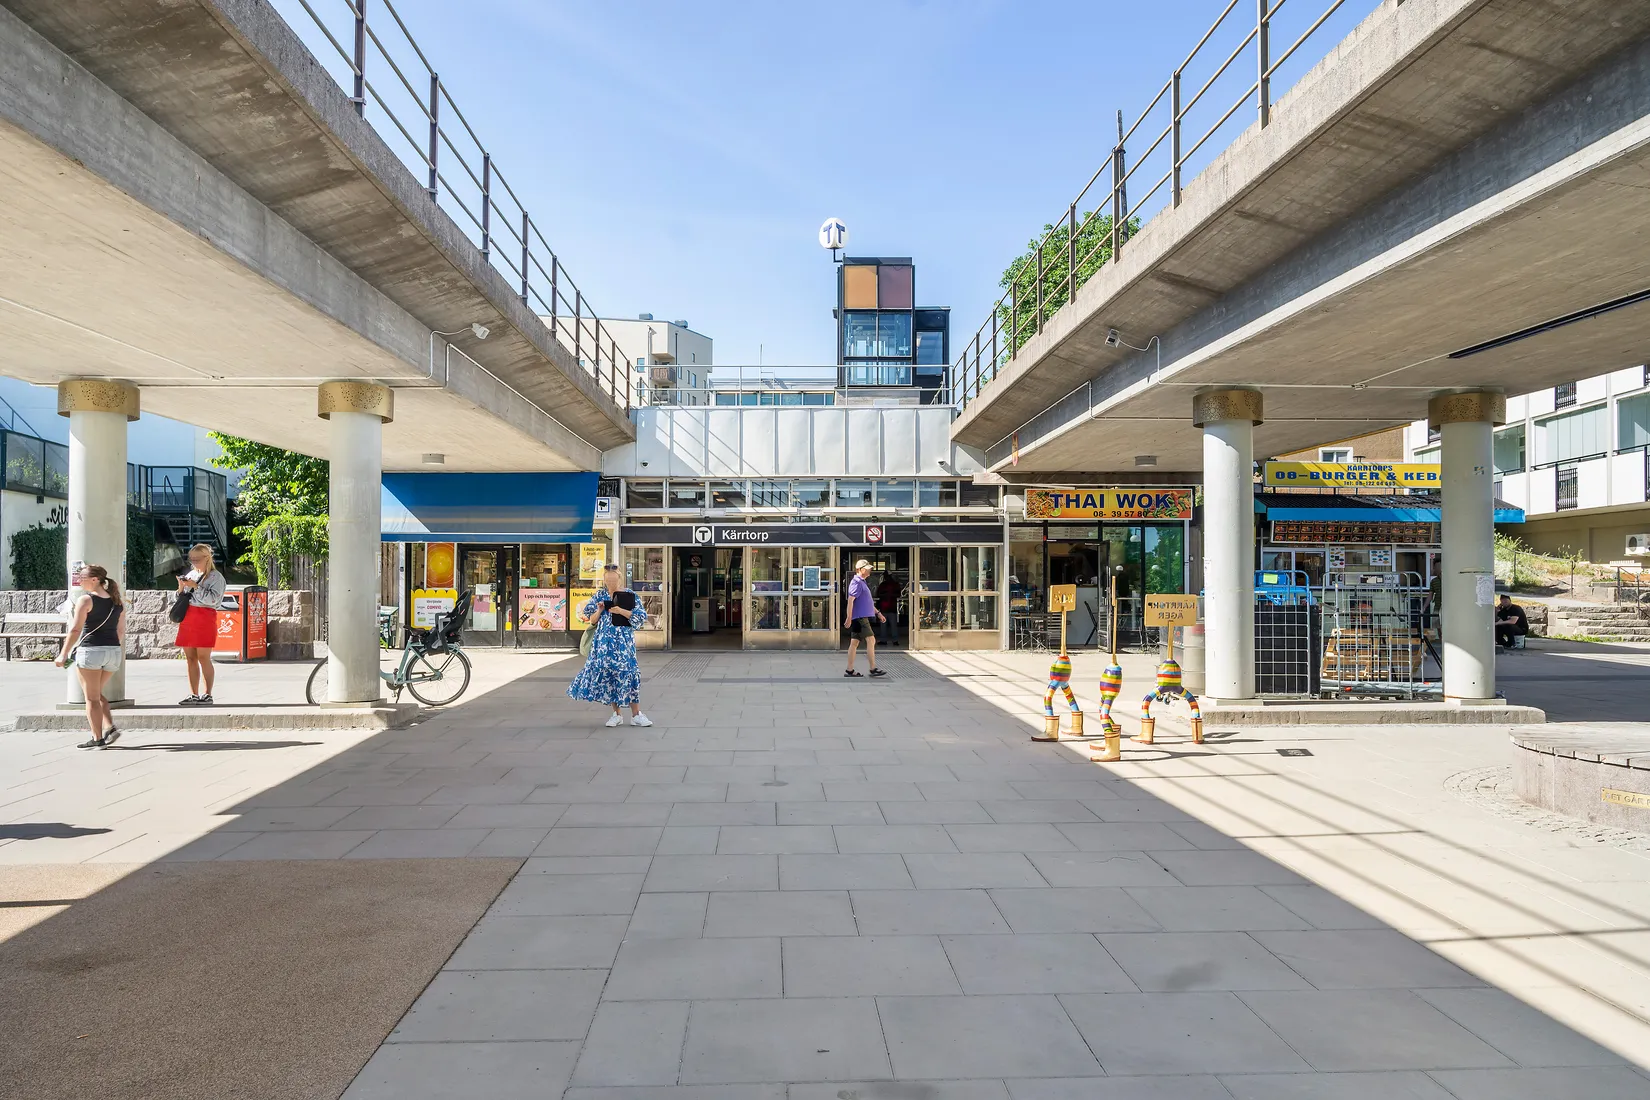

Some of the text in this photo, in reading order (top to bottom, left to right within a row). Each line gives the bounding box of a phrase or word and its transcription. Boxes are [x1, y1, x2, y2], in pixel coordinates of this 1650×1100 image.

[836, 222, 845, 244] T
[1386, 471, 1397, 481] &
[1404, 471, 1442, 481] KEB
[1049, 493, 1171, 509] THAI WOK
[1093, 510, 1148, 518] 08- 39 57 80
[698, 530, 709, 541] T
[722, 529, 769, 542] Kärrtorp
